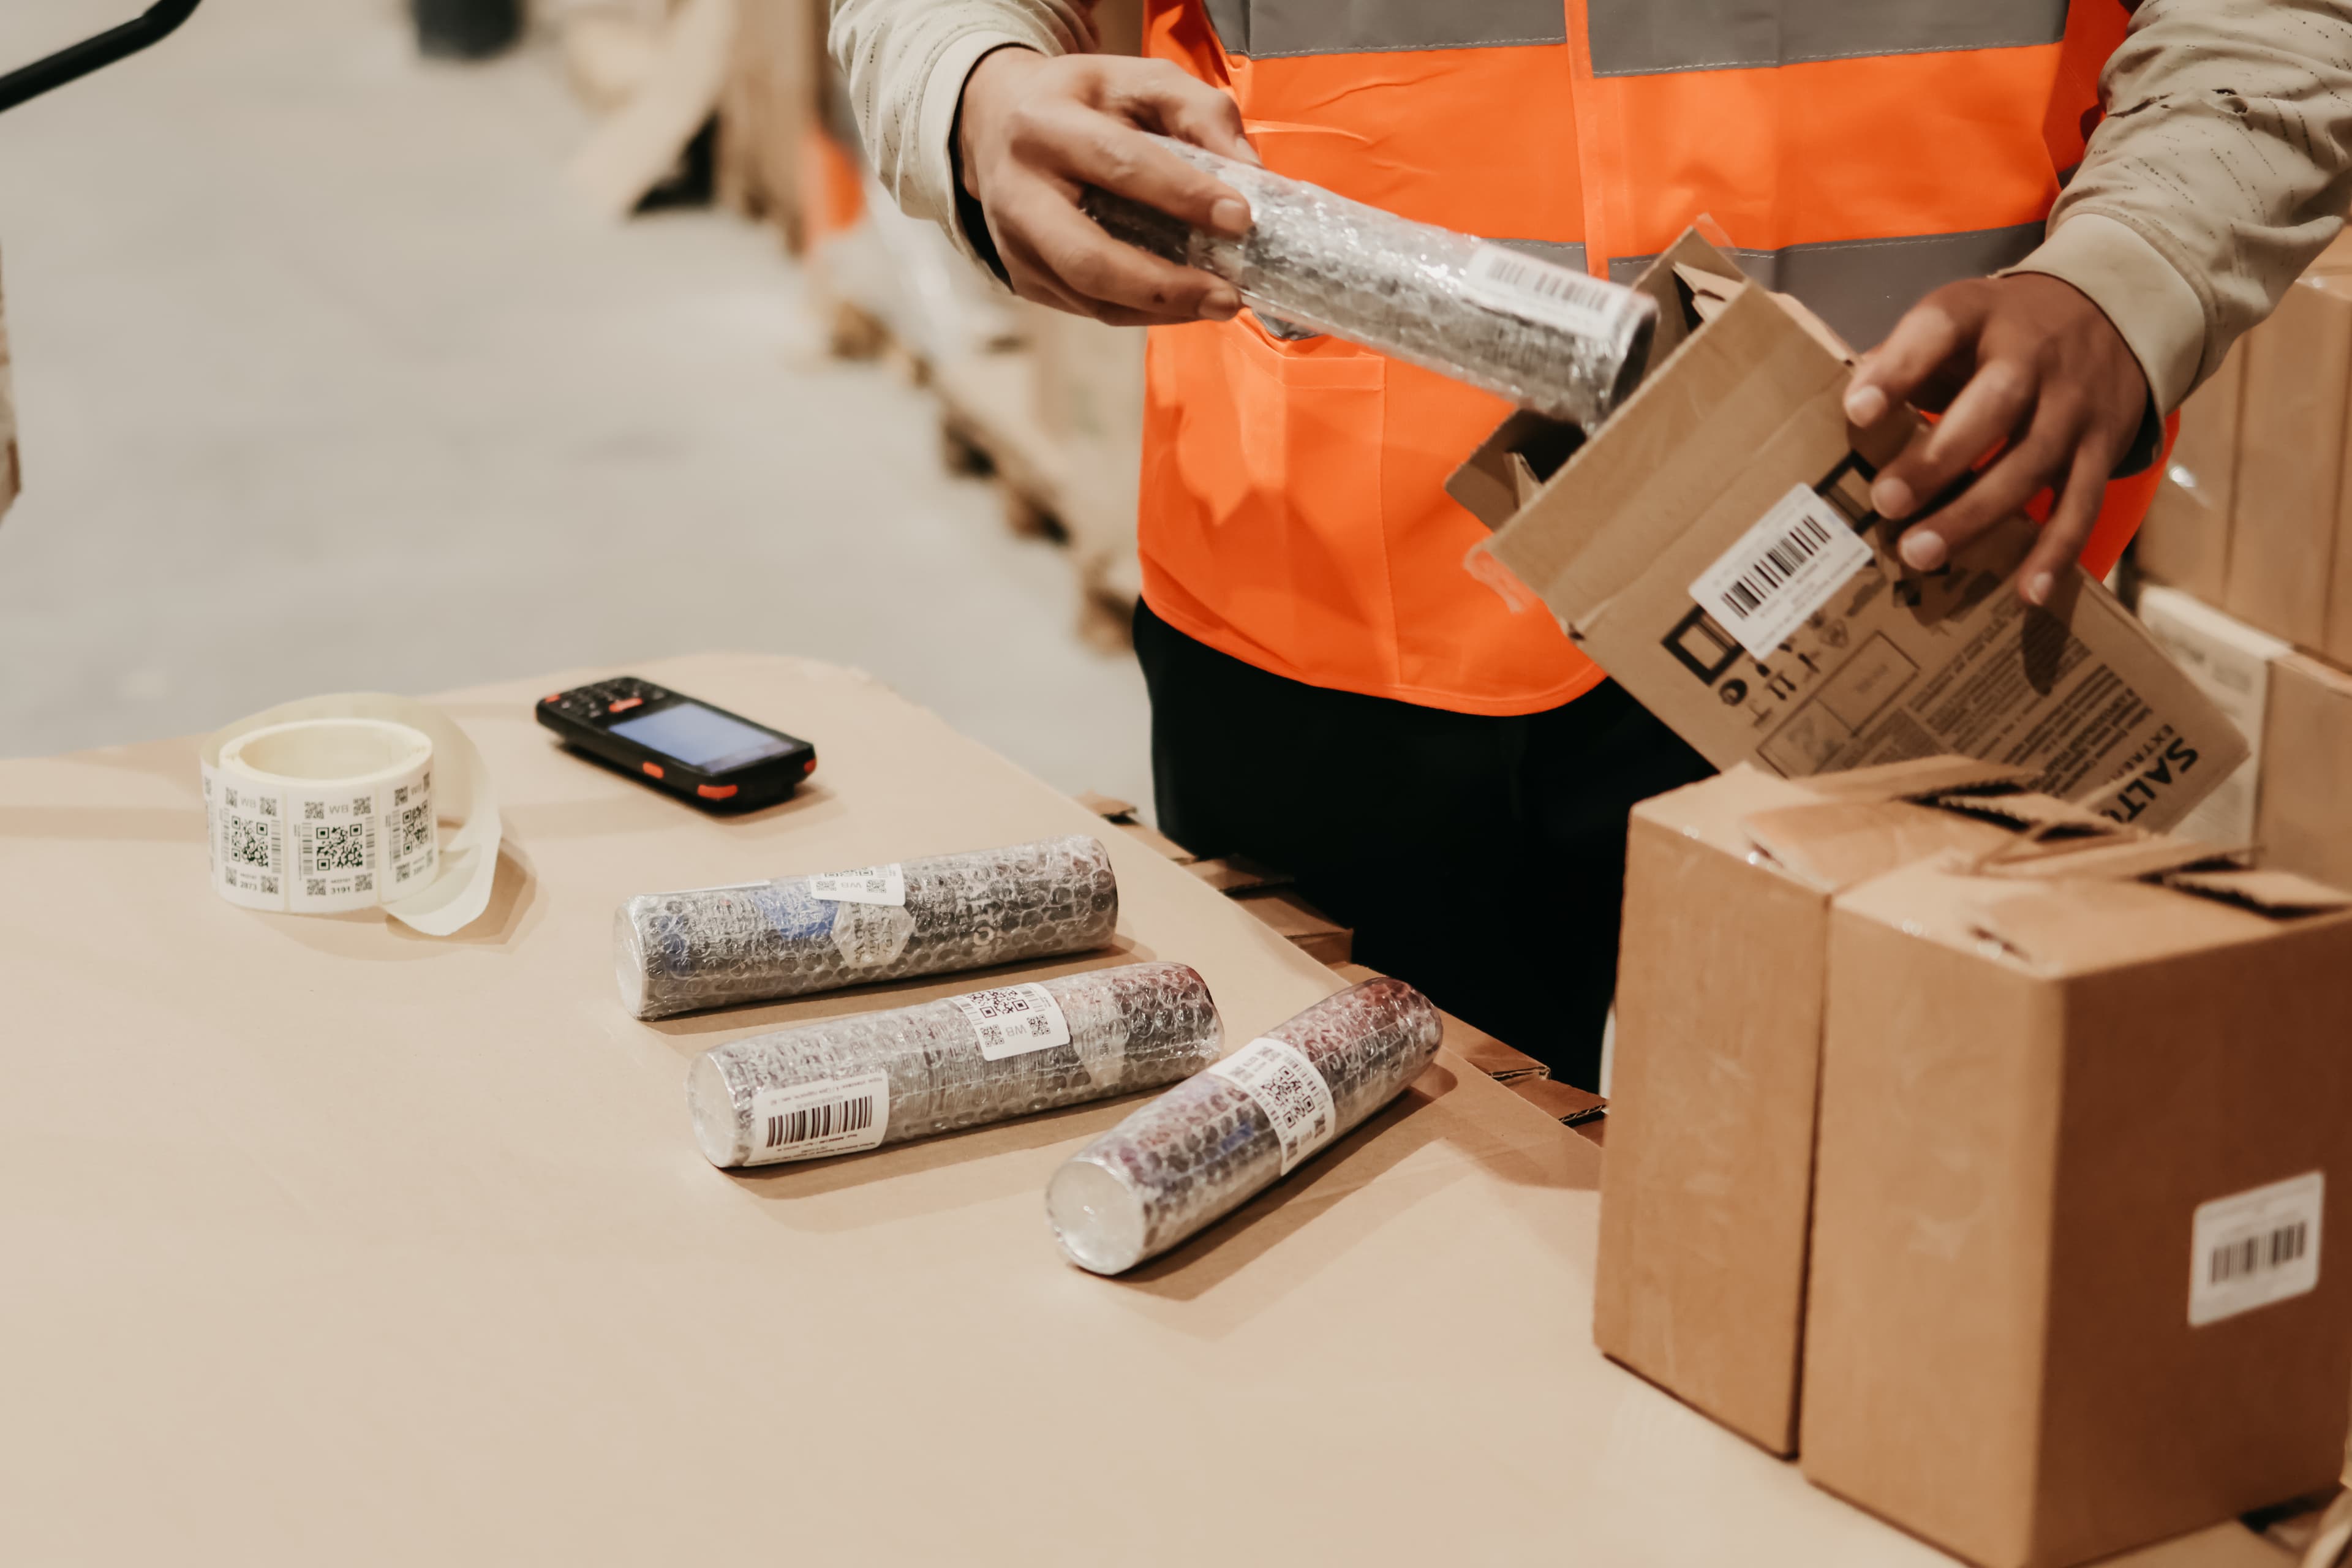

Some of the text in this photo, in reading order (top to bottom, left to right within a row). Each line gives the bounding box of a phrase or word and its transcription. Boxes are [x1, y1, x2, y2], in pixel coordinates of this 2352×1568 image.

[240, 797, 257, 809] WB
[329, 805, 349, 814] WB
[1005, 1024, 1028, 1037] WB
